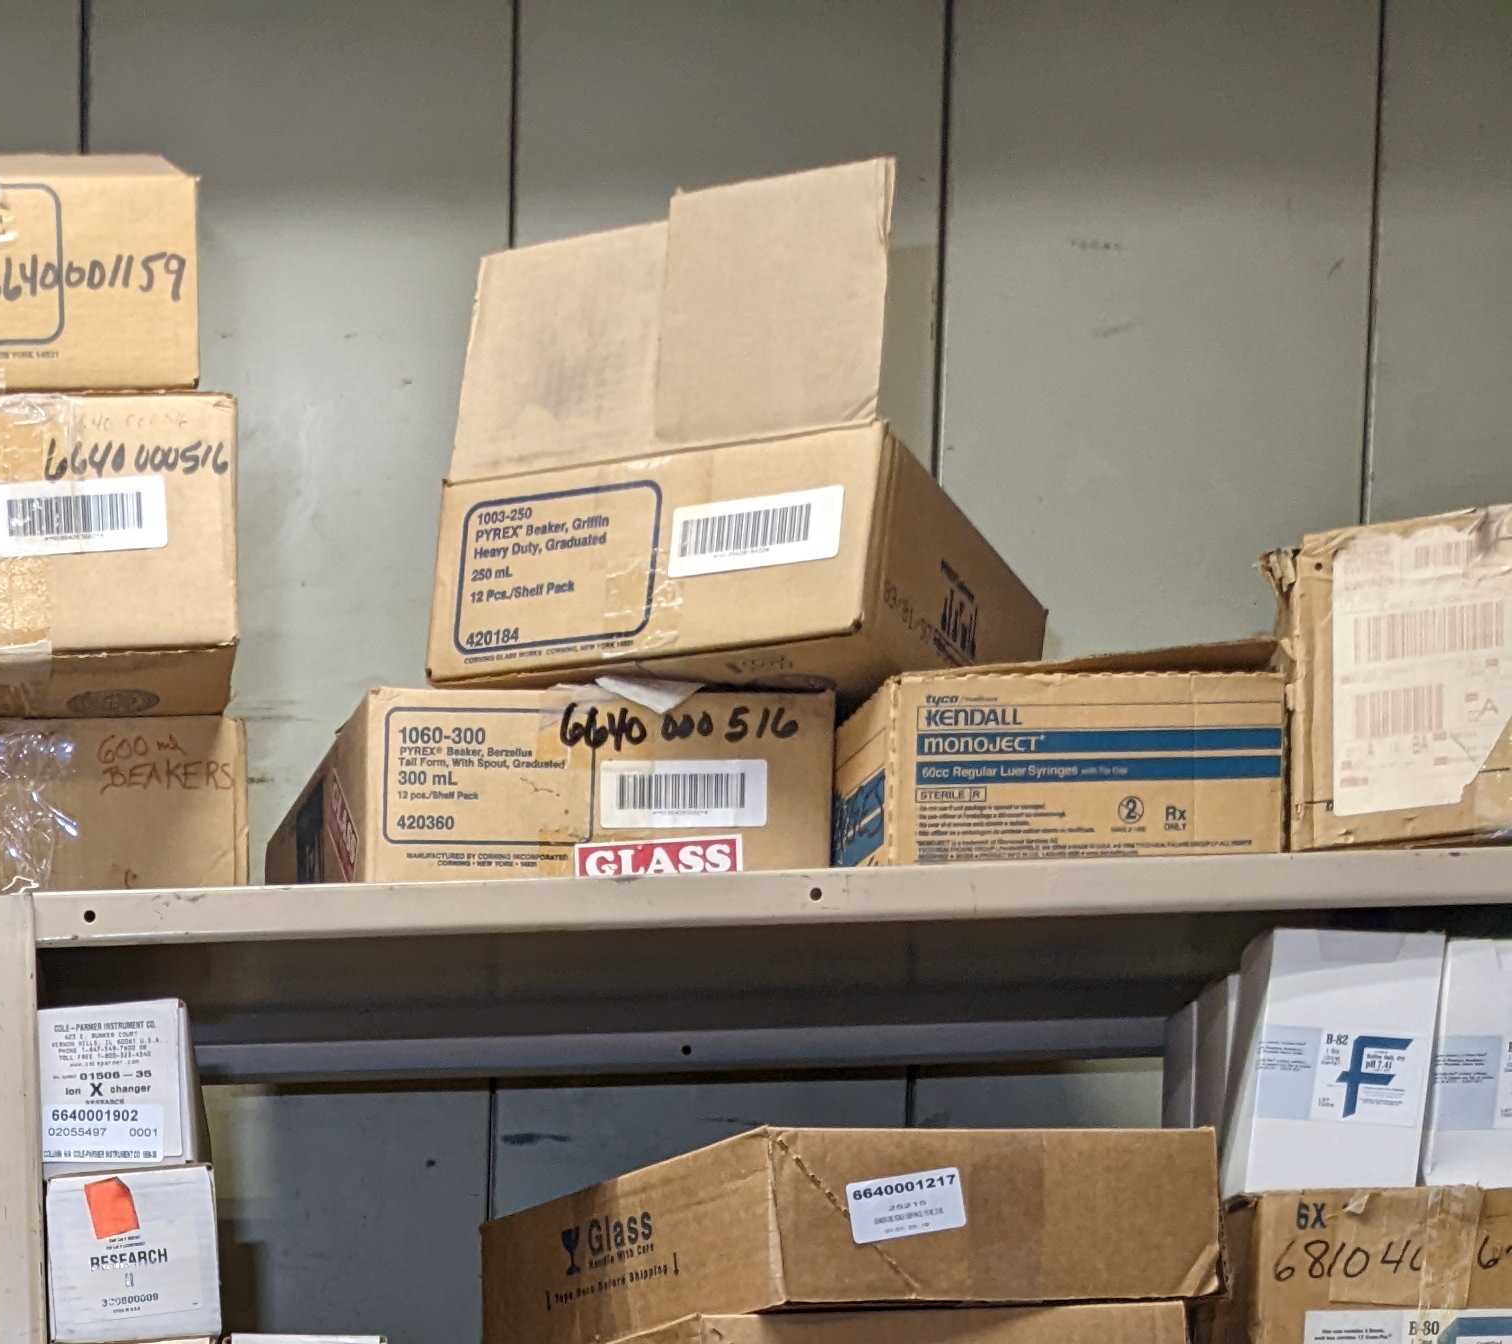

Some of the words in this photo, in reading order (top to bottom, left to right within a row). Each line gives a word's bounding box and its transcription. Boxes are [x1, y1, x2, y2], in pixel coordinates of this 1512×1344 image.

[477, 507, 532, 525] 1003-250
[526, 519, 569, 537] Beaker,
[573, 515, 610, 532] Griffin
[474, 544, 508, 561] Heavy
[512, 540, 542, 557] Duty,
[546, 533, 607, 552] Graduated
[471, 568, 491, 581] 250
[546, 580, 574, 595] Pack
[466, 628, 519, 648] 420184
[924, 708, 1022, 727] KENDALL
[399, 727, 486, 744] 1060-300
[97, 734, 147, 764] 600
[101, 760, 233, 795] BEAKERS
[398, 771, 427, 785] 300
[430, 771, 458, 786] mL
[922, 766, 950, 779] 60cc
[953, 765, 997, 779] Regular
[1000, 765, 1027, 777] Luer
[1028, 764, 1078, 779] Syringes
[920, 790, 965, 801] STERILE
[397, 815, 455, 830] 420360
[585, 844, 732, 876] GLASS
[1326, 1034, 1349, 1045] B-82
[1365, 1060, 1376, 1071] pH
[90, 1083, 103, 1097] X
[110, 1083, 151, 1094] changer
[51, 1109, 139, 1122] 6640001902
[48, 1128, 107, 1137] 02055497
[129, 1128, 158, 1137] 0001
[852, 1173, 956, 1201] 6640001217
[588, 1211, 653, 1256] Glass
[90, 1248, 168, 1272] RESEARCH
[629, 1263, 668, 1285] Shipping
